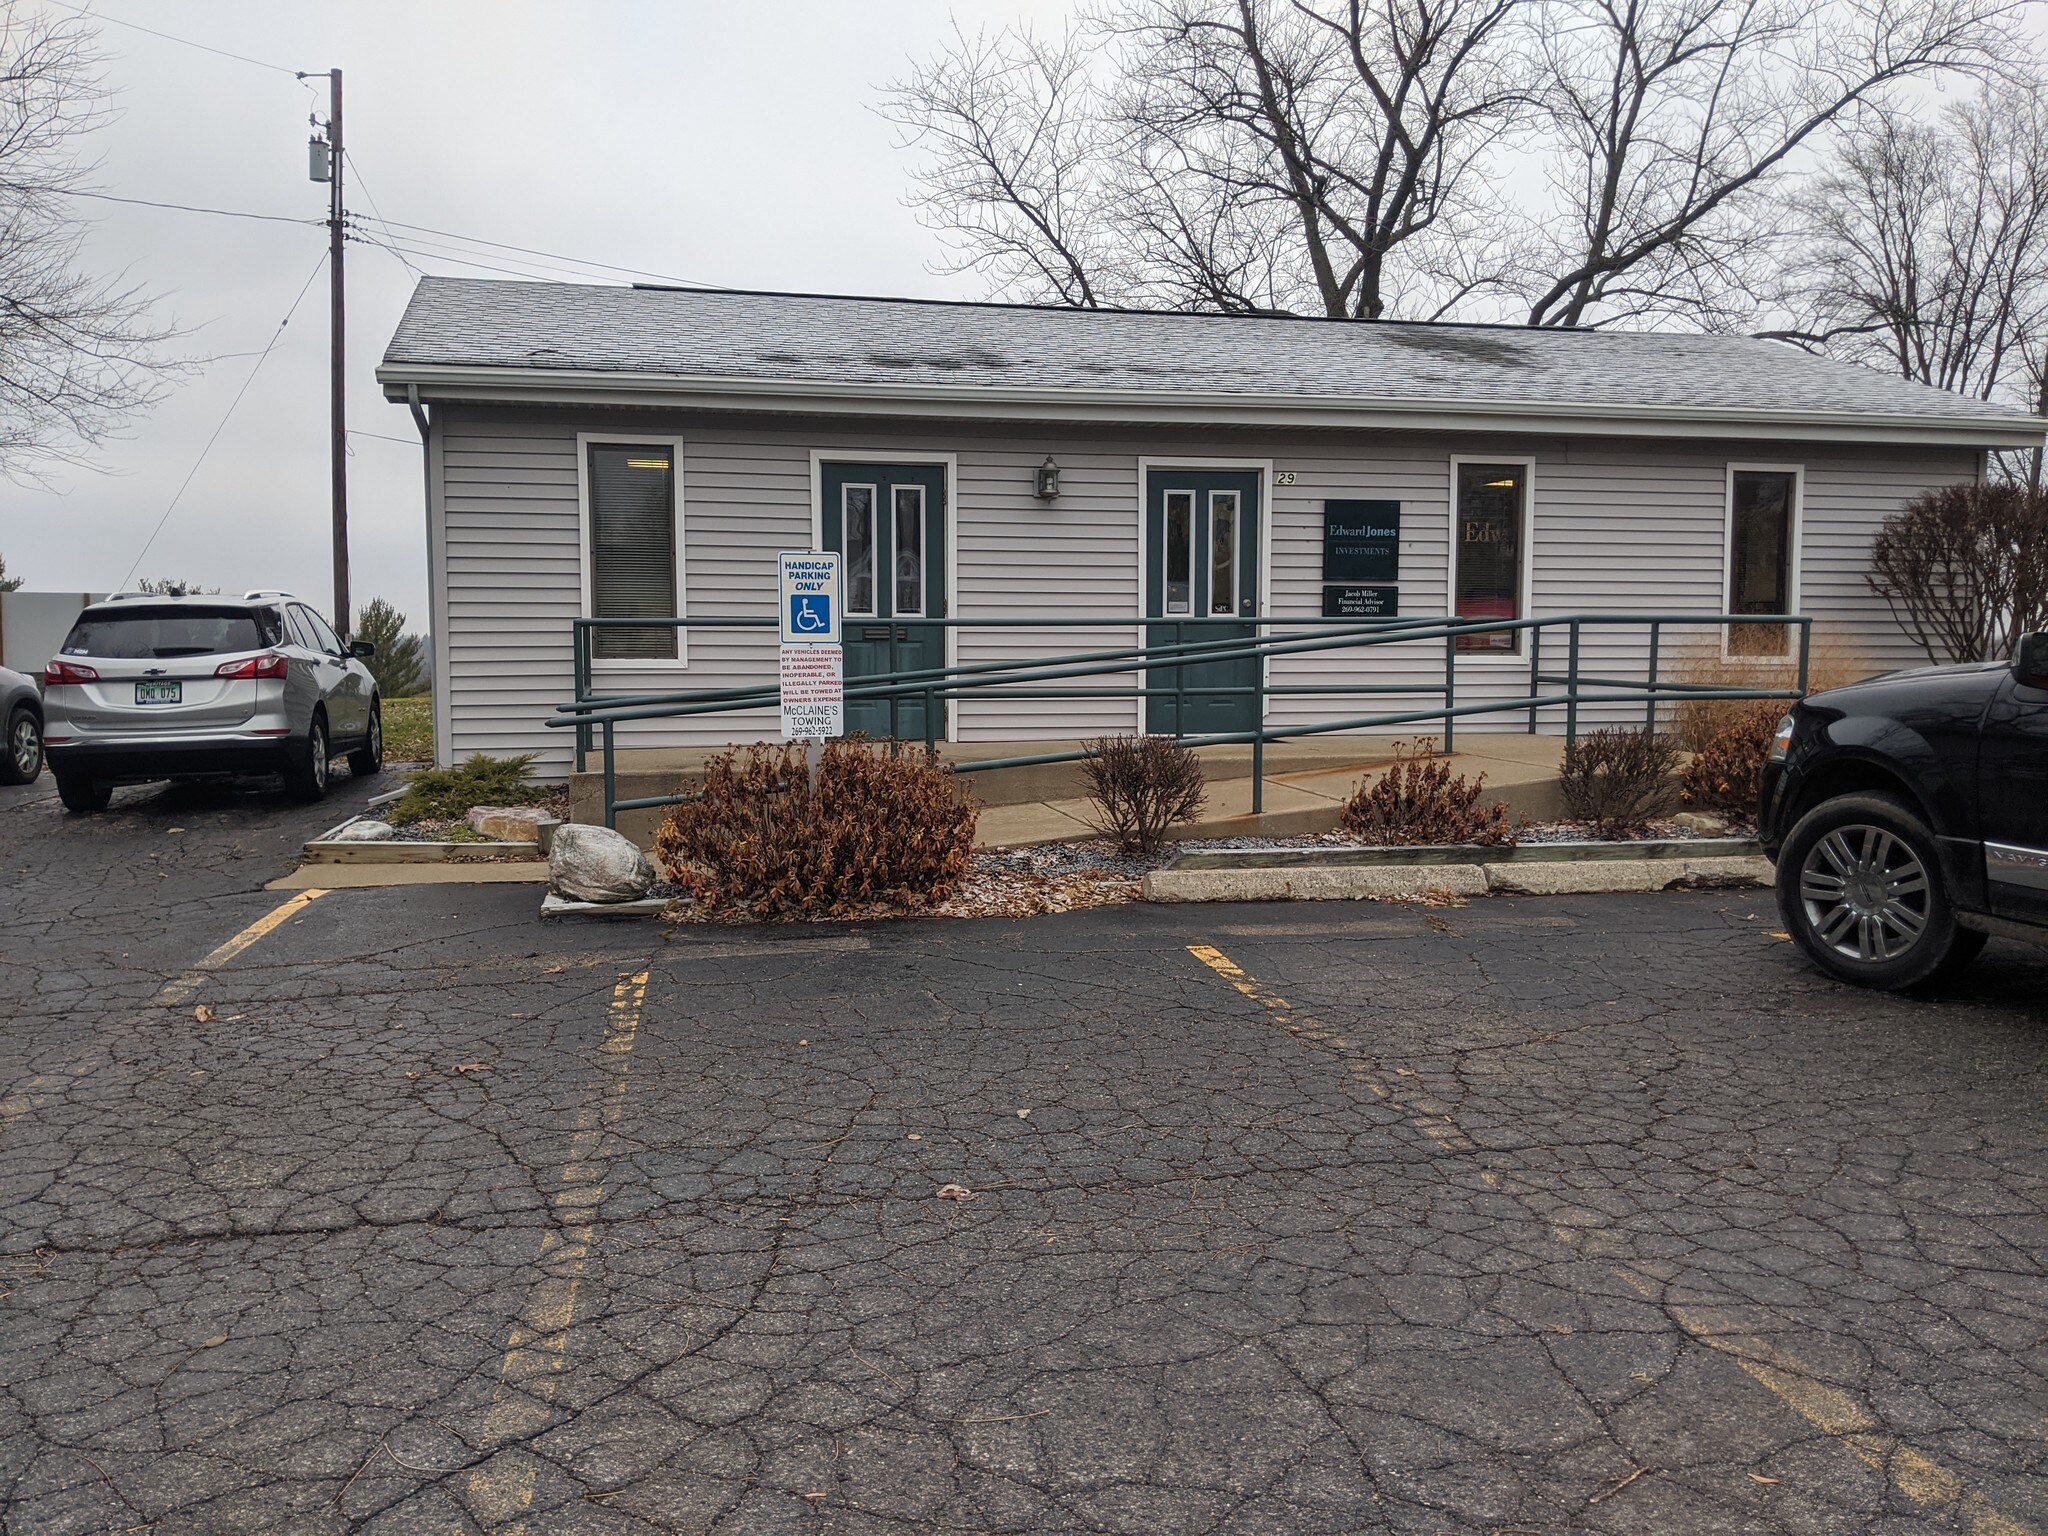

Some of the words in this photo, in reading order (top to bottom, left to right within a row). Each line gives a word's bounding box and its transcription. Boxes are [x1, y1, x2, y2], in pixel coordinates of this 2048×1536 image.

[1278, 473, 1295, 484] 29
[1335, 547, 1390, 555] INVESTMENTS
[784, 561, 834, 570] HANDICAP
[788, 571, 831, 580] PARKING
[795, 582, 824, 591] ONLY
[1338, 597, 1362, 605] Financial
[1363, 597, 1384, 605] Advisor
[783, 705, 838, 716] McCLAINE'S
[792, 717, 832, 726] TOWING
